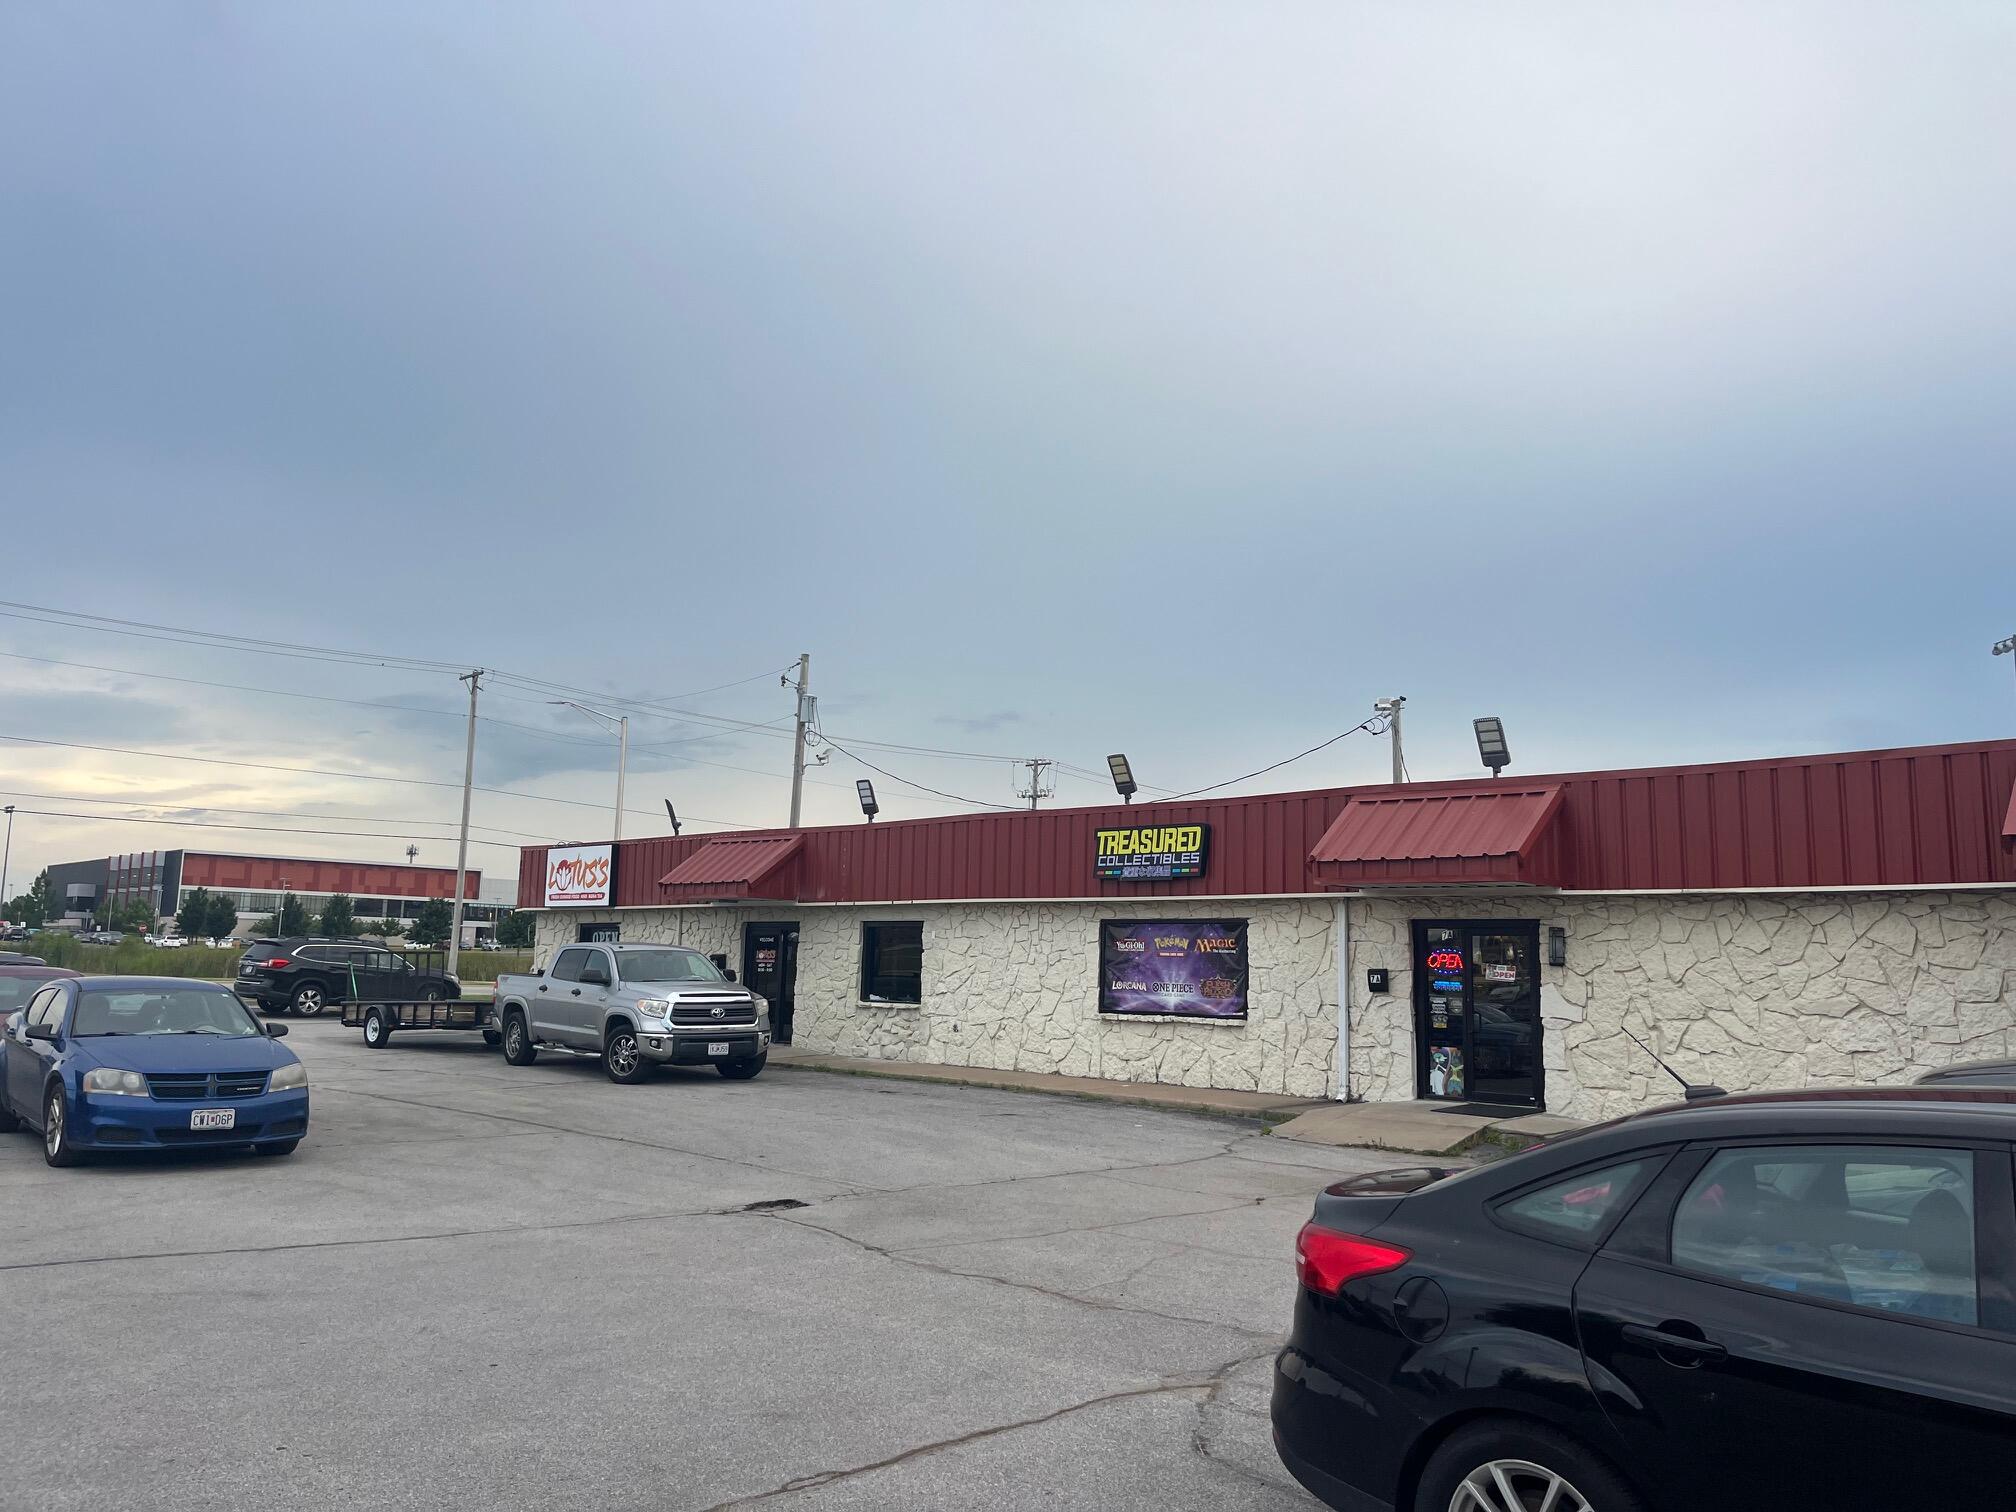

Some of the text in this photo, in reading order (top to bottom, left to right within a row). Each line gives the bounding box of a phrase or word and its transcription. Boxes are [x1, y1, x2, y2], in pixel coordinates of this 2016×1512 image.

[1097, 826, 1202, 855] TREASURED
[1097, 852, 1200, 867] COLLECTIBLES
[1426, 953, 1464, 969] OPEN
[1494, 971, 1515, 979] OPEN
[1112, 980, 1147, 992] LORCANA
[1152, 982, 1194, 993] ONE PIECE
